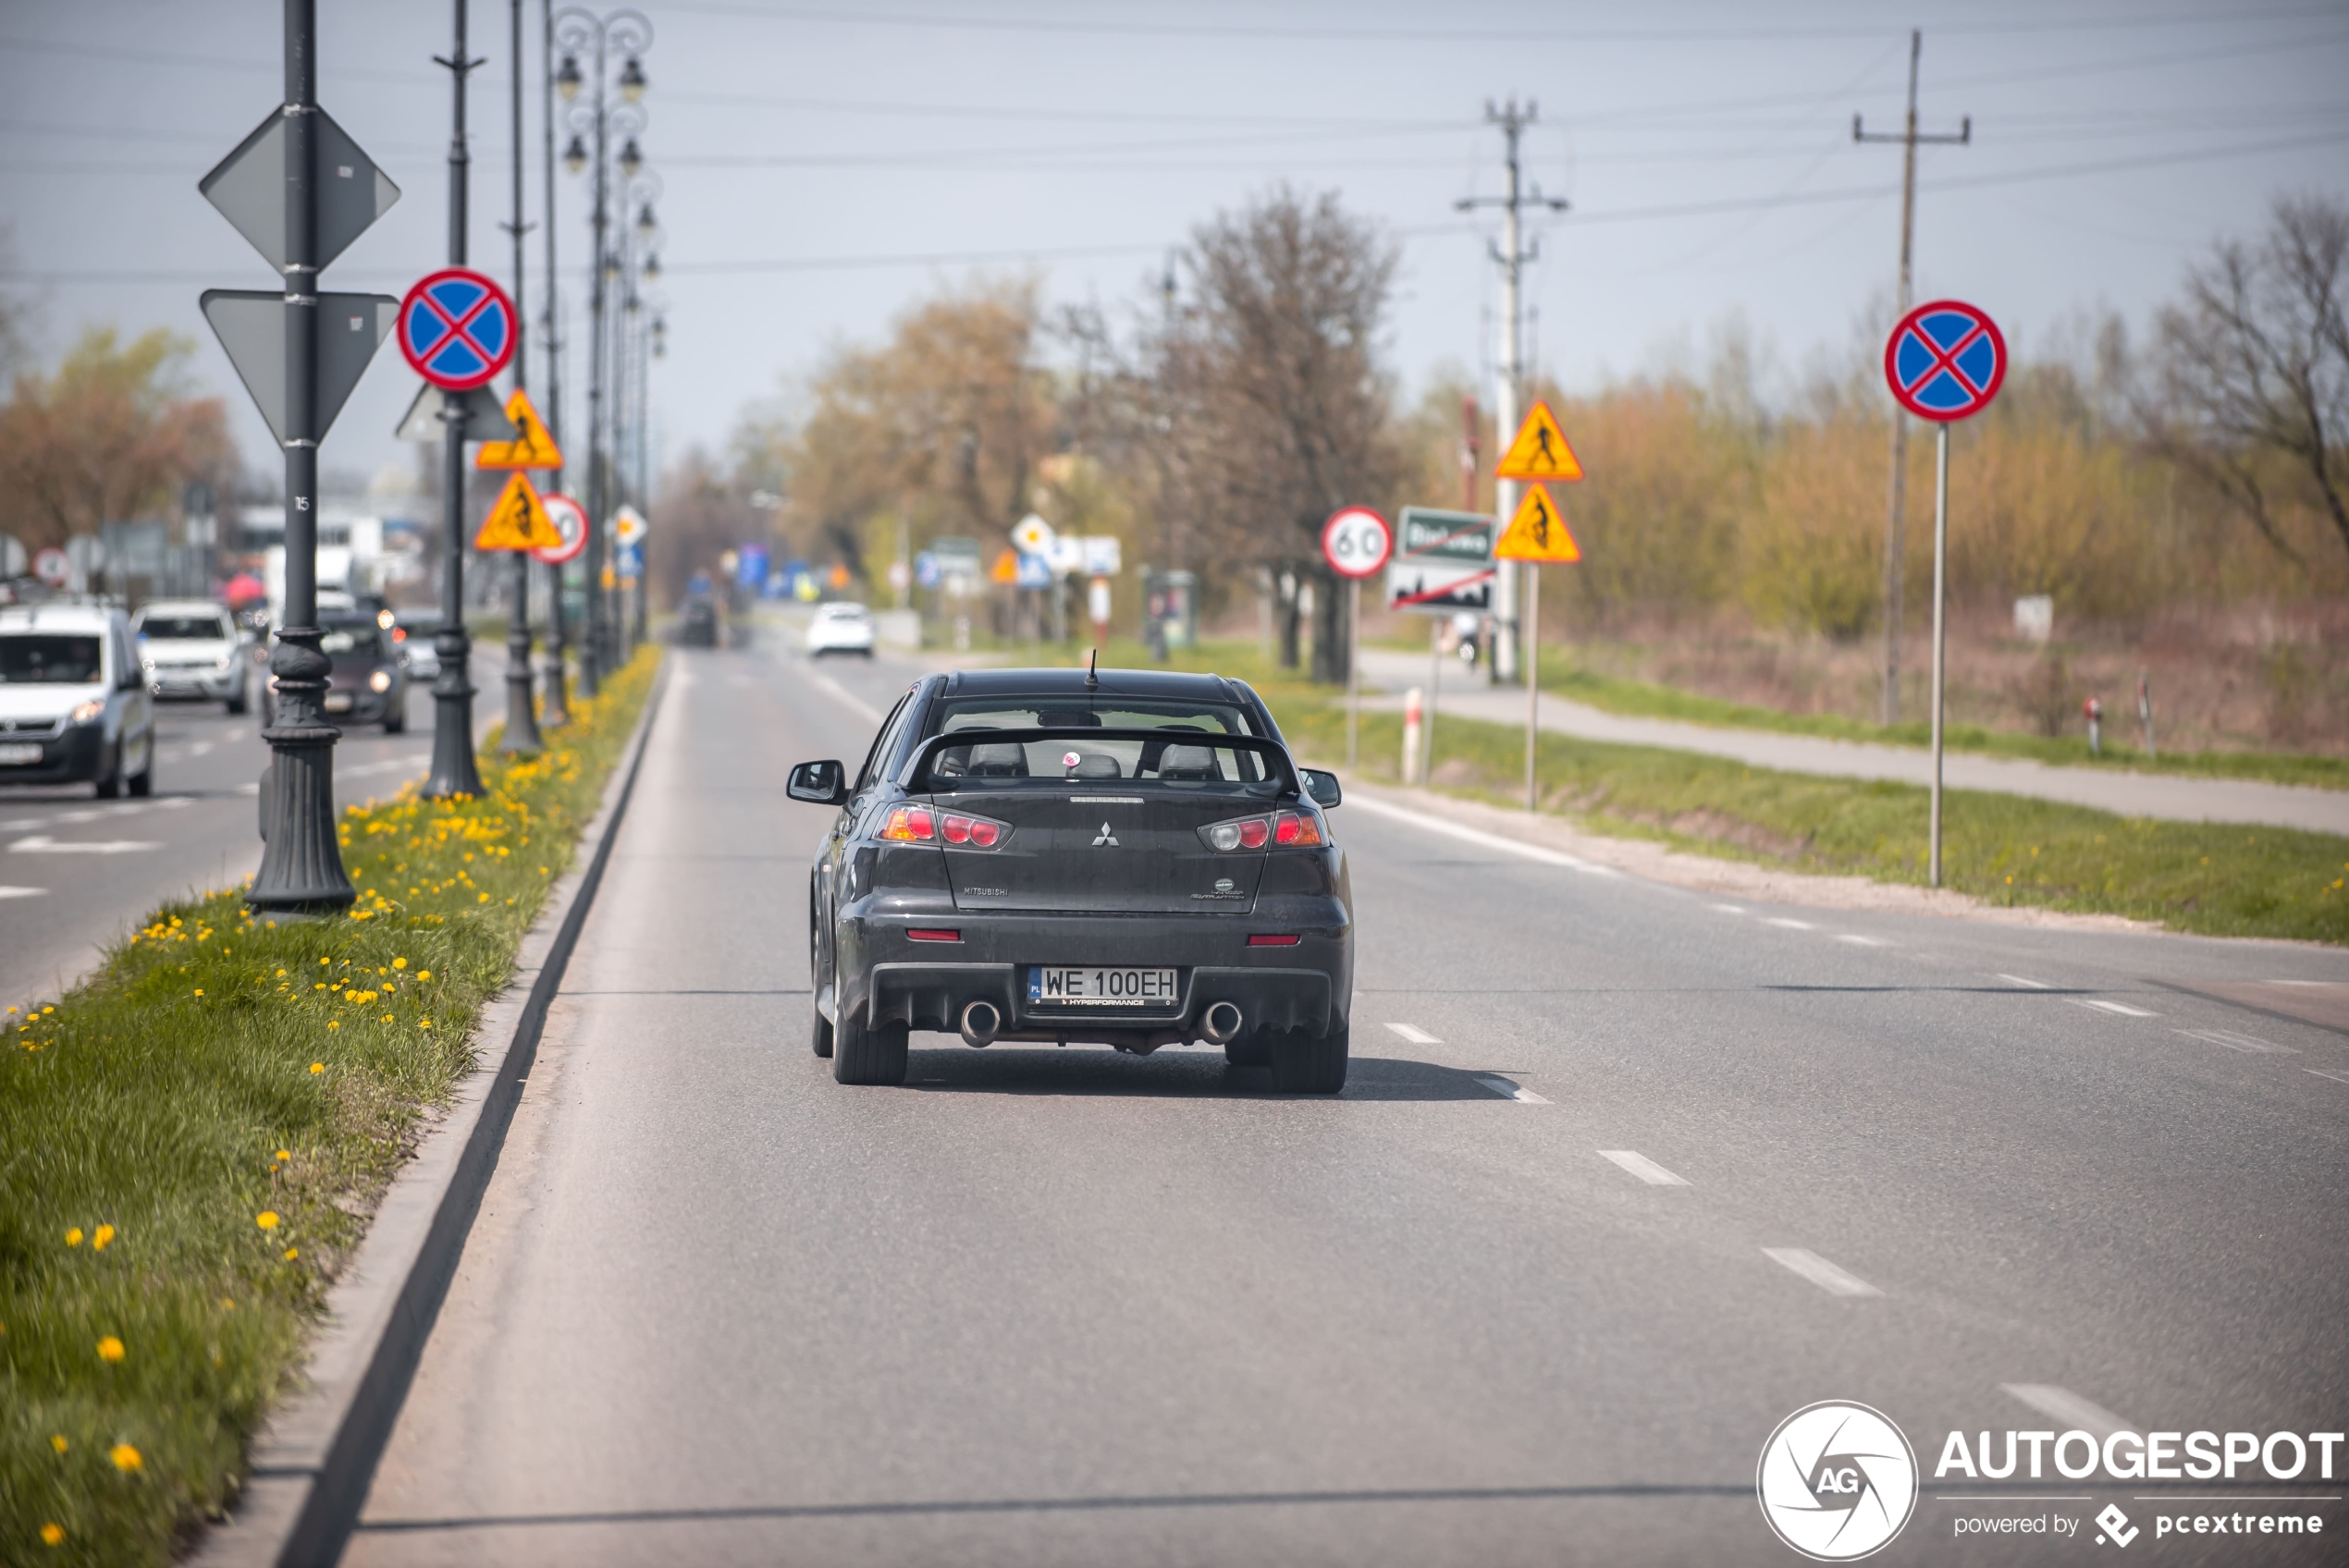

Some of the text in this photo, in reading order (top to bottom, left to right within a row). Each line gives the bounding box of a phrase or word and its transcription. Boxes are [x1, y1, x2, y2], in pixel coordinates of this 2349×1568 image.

[295, 496, 310, 511] 15
[1334, 525, 1383, 558] 60
[964, 887, 1008, 897] MITSUBISHI
[1046, 971, 1174, 997] WE 100EH
